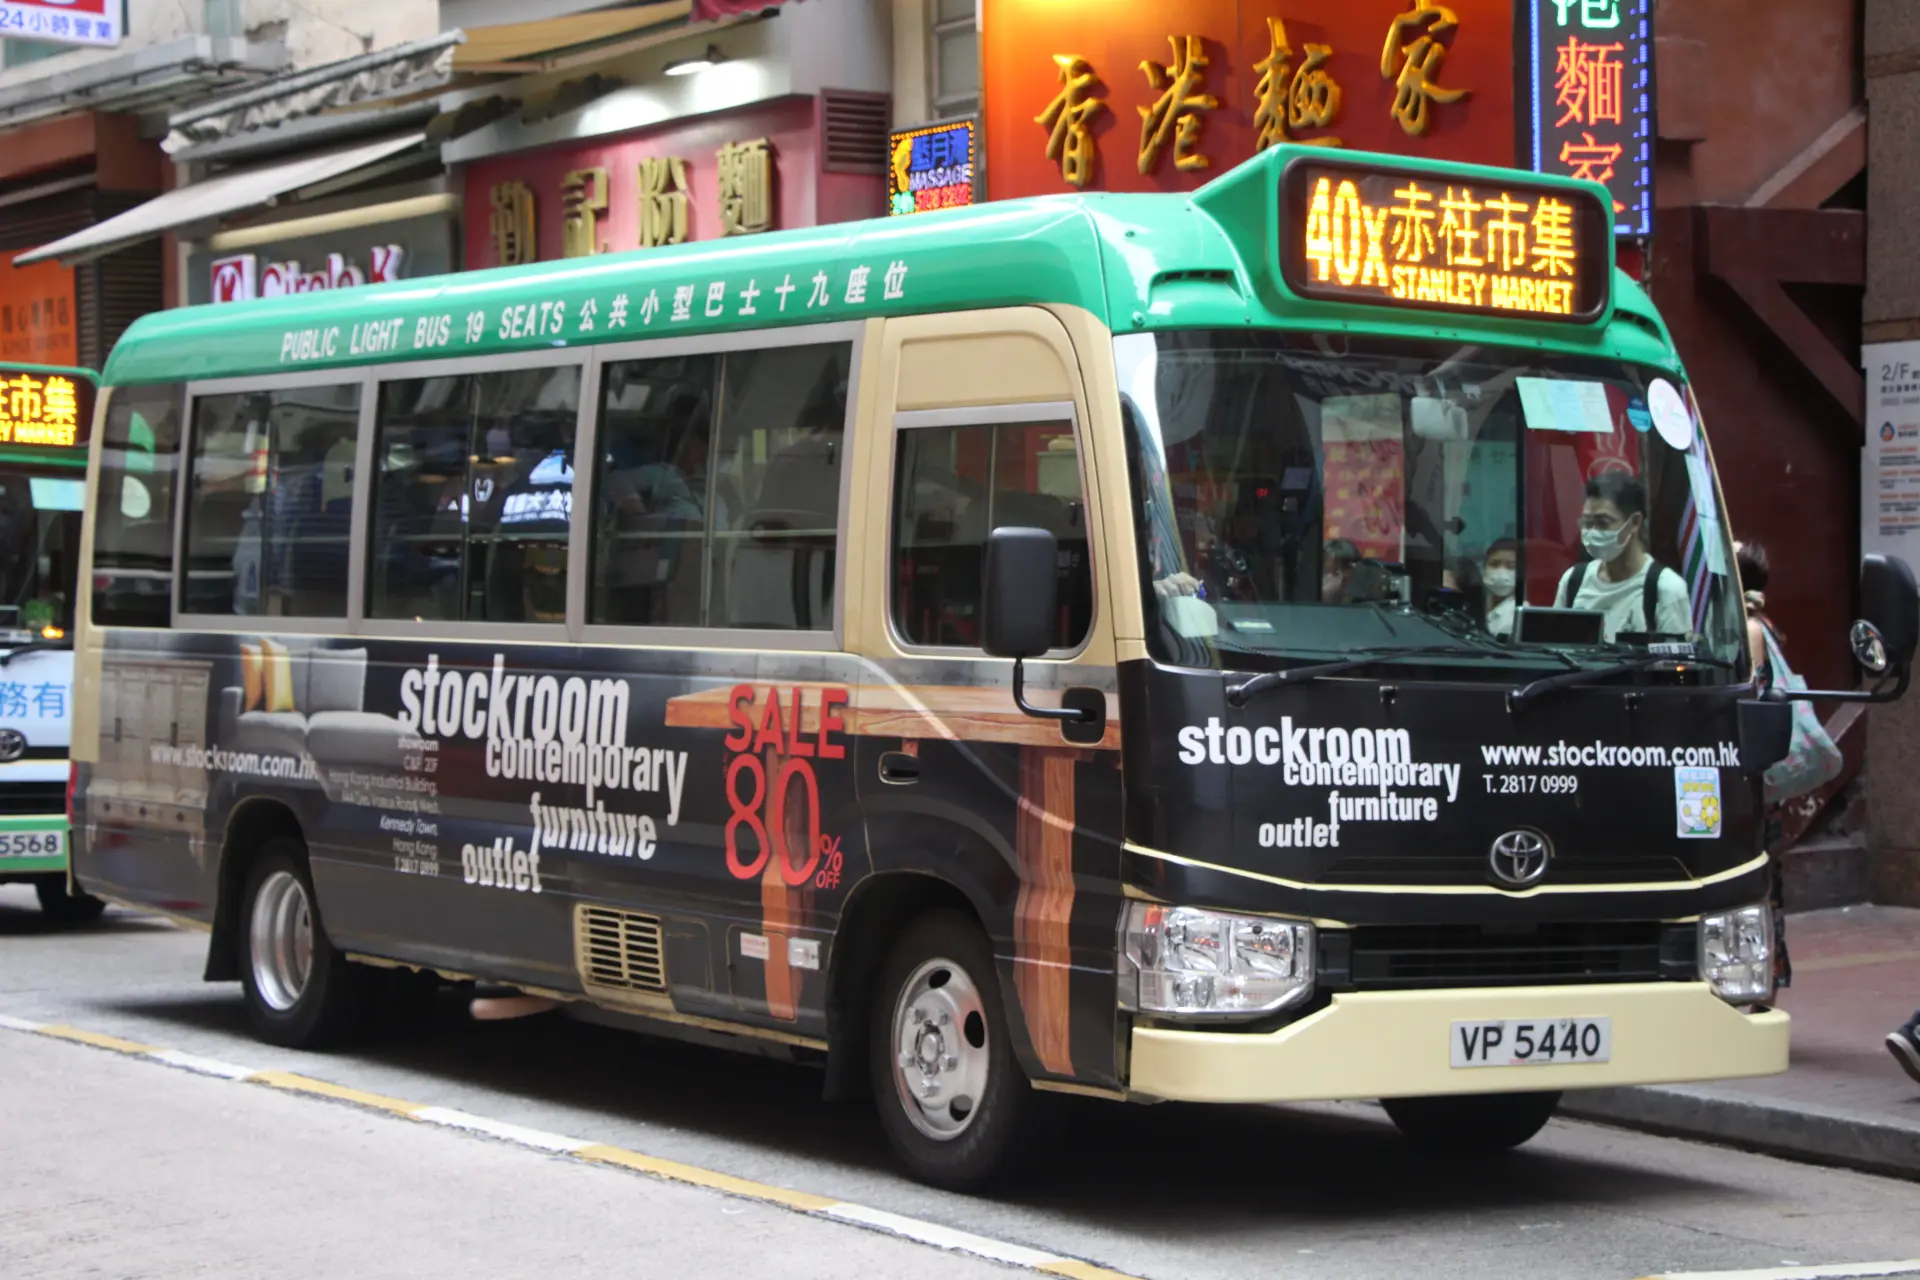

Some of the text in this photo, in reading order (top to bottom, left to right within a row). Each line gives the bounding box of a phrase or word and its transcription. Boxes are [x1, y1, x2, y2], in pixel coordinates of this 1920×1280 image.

[910, 163, 972, 193] MASSAGE
[1389, 181, 1576, 276] 赤柱市集
[1391, 264, 1573, 314] STANLEY MARKET
[280, 259, 908, 363] PUBLIC LIGHT BUS 19 SEATS 公共小型巴士十九座位
[14, 421, 76, 446] MARKET
[0, 679, 73, 719] 務有
[398, 653, 631, 748] stockroom
[724, 683, 849, 760] SALE
[1178, 716, 1411, 765] stockroom
[149, 742, 318, 782] www.stockroom.com.hk
[1481, 739, 1740, 767] www.stockroom.com.hk
[485, 736, 689, 826] contemporary
[1283, 758, 1461, 803] contemporary
[1483, 774, 1578, 793] T. 2817 0999
[530, 791, 657, 860] furniture
[1328, 791, 1438, 823] furniture
[0, 834, 58, 854] 5568
[1258, 817, 1340, 847] outlet
[462, 836, 542, 893] outlet
[815, 870, 841, 889] OFF
[1460, 1023, 1600, 1061] VP 5440
